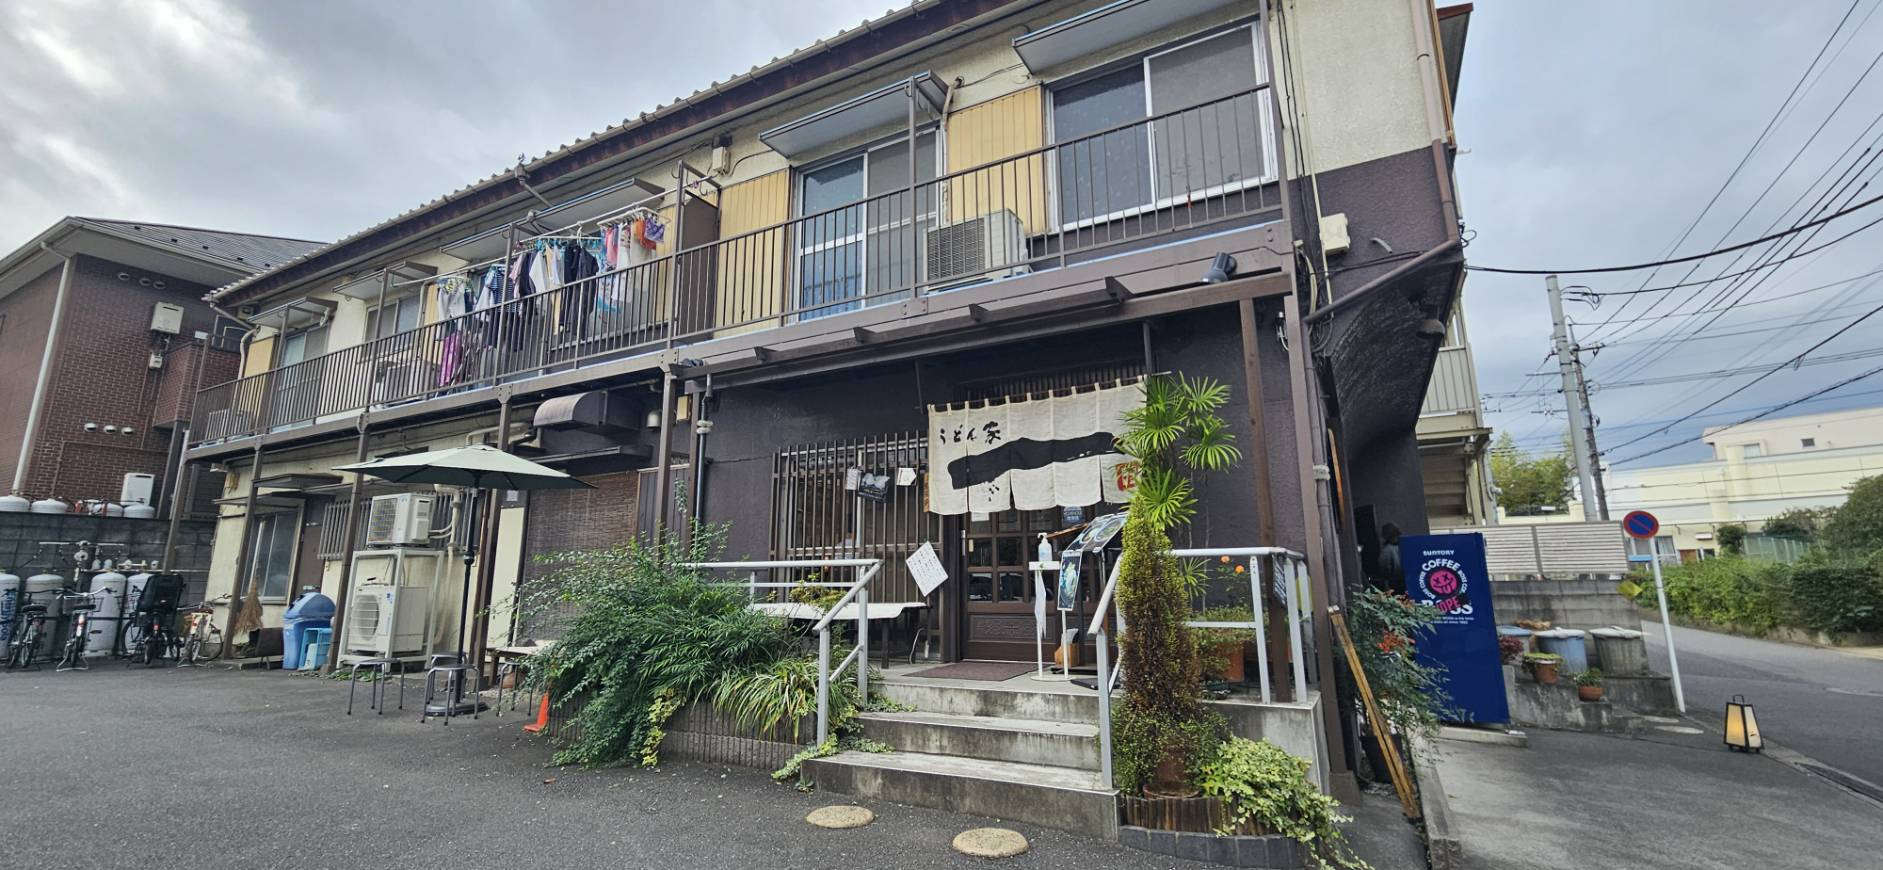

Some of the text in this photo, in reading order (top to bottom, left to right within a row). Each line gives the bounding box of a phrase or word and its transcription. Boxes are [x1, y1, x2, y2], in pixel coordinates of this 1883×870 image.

[940, 421, 1001, 445] うどん家
[1422, 558, 1461, 571] COFFEE
